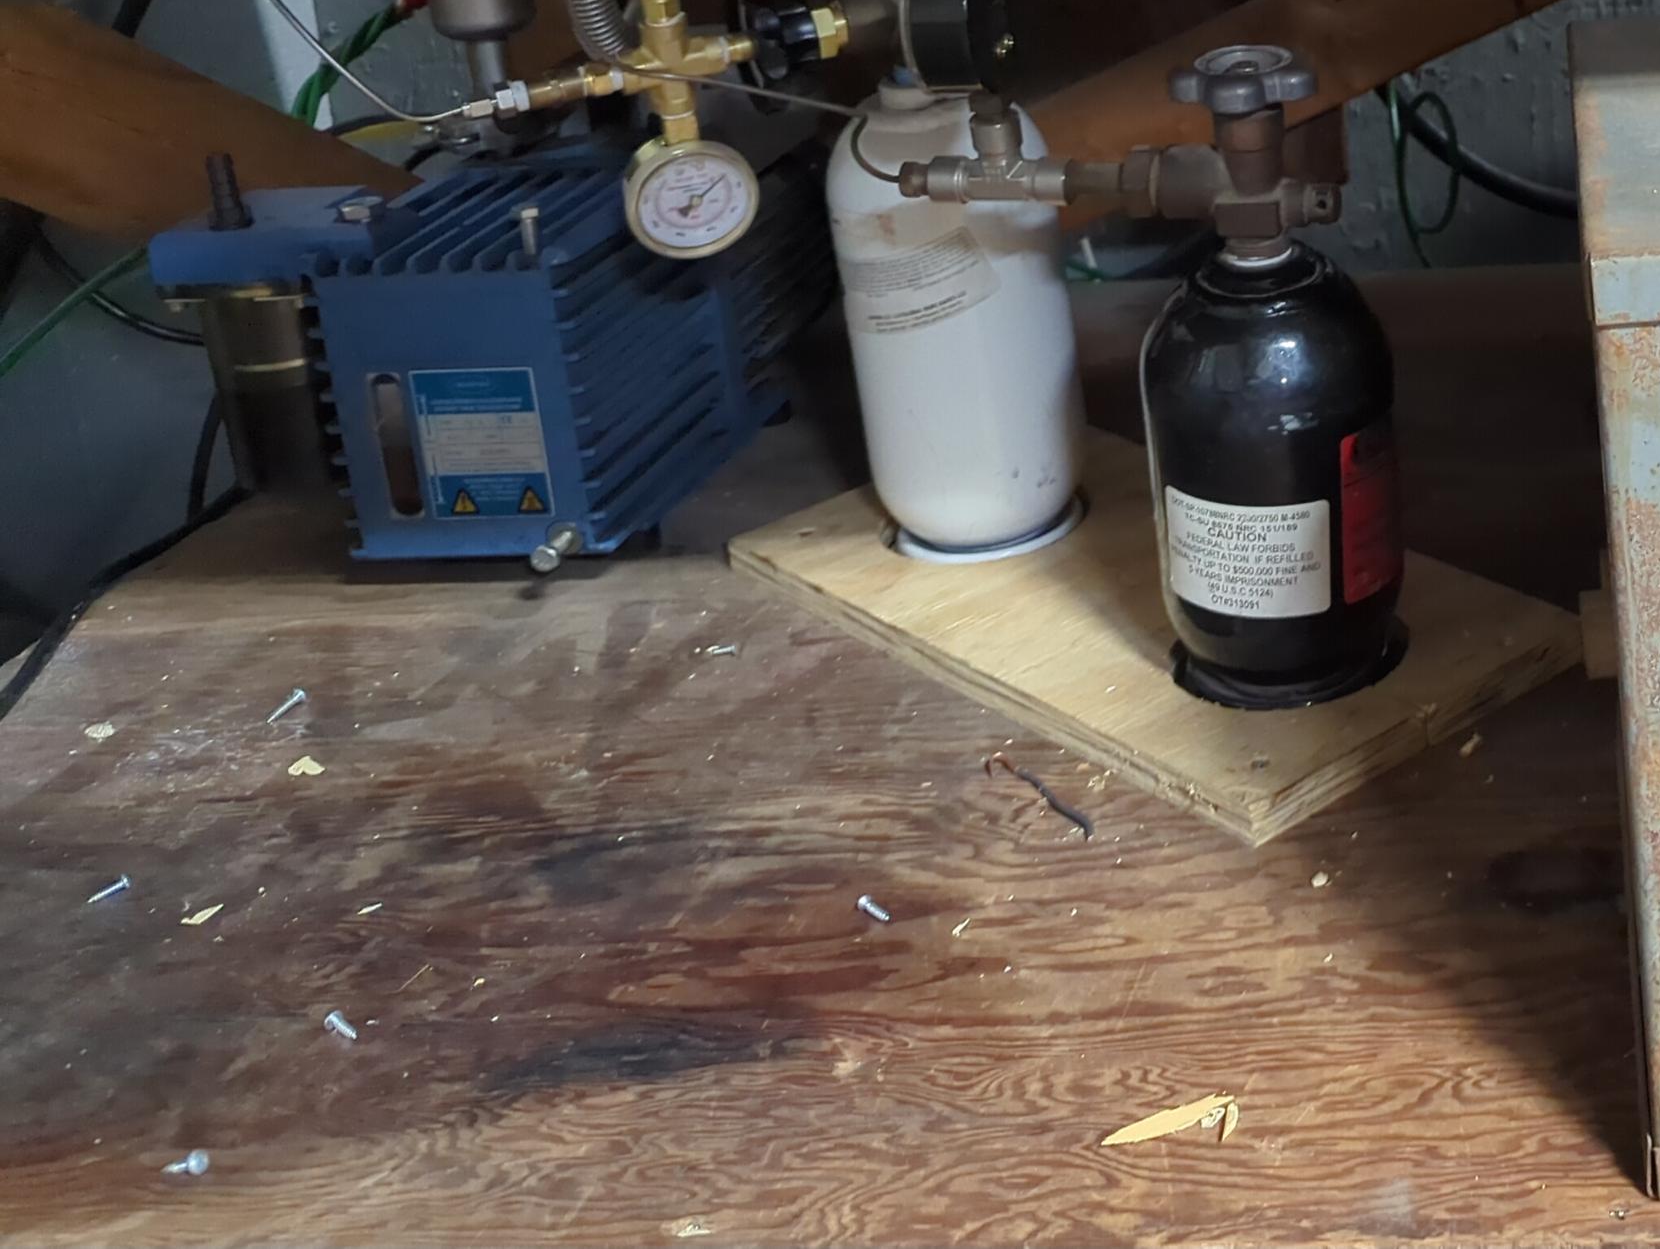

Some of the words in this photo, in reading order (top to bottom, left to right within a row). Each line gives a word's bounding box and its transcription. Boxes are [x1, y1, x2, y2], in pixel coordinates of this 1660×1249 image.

[1186, 531, 1225, 550] FEDERAL
[1226, 542, 1250, 553] LAW
[1251, 542, 1297, 554] FORBIDS
[1207, 526, 1268, 543] CAUTION
[1174, 535, 1250, 563] TRANSPORTATION
[1265, 550, 1315, 564] REFILLED
[1195, 566, 1223, 582] YEARS
[1224, 575, 1299, 587] IMPRISONMENT
[1218, 562, 1231, 573] TO
[1275, 565, 1297, 575] FINE
[1300, 560, 1322, 572] AND
